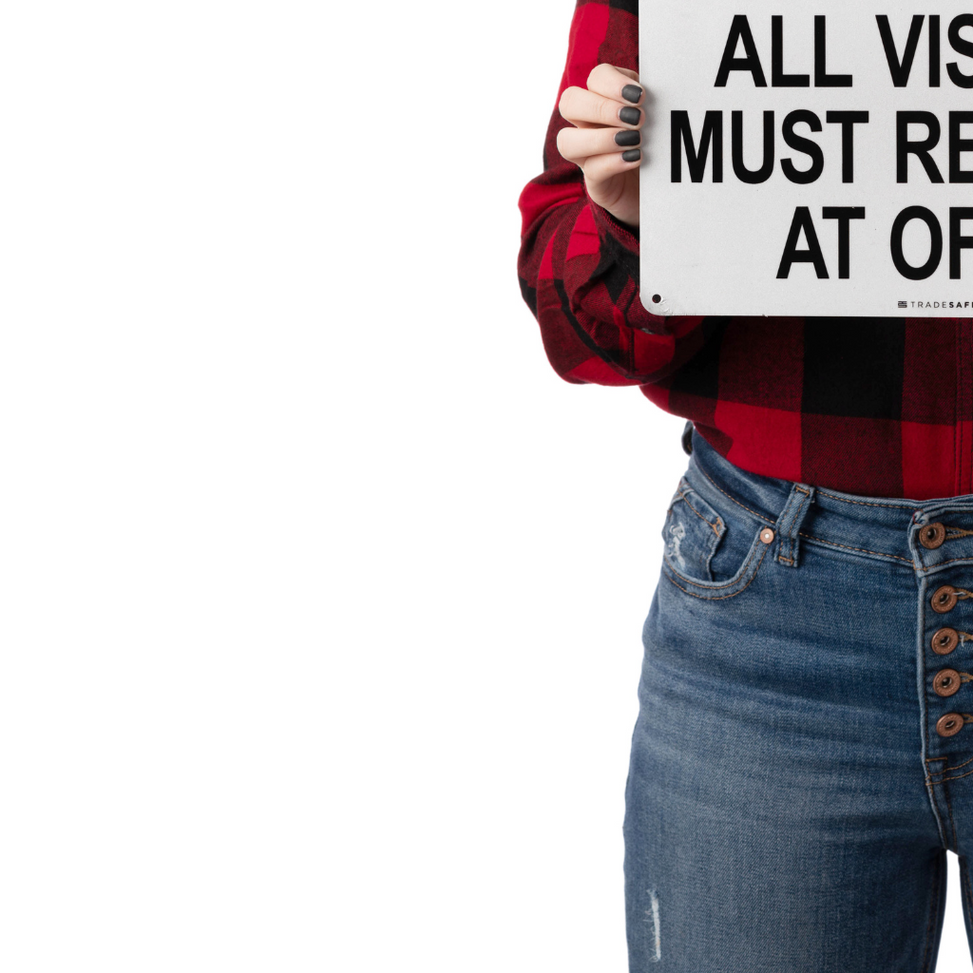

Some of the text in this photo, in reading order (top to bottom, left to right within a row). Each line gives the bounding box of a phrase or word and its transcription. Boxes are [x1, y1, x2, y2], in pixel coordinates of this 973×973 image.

[713, 14, 853, 88] ALL
[670, 109, 870, 185] MUST
[775, 206, 866, 280] AT
